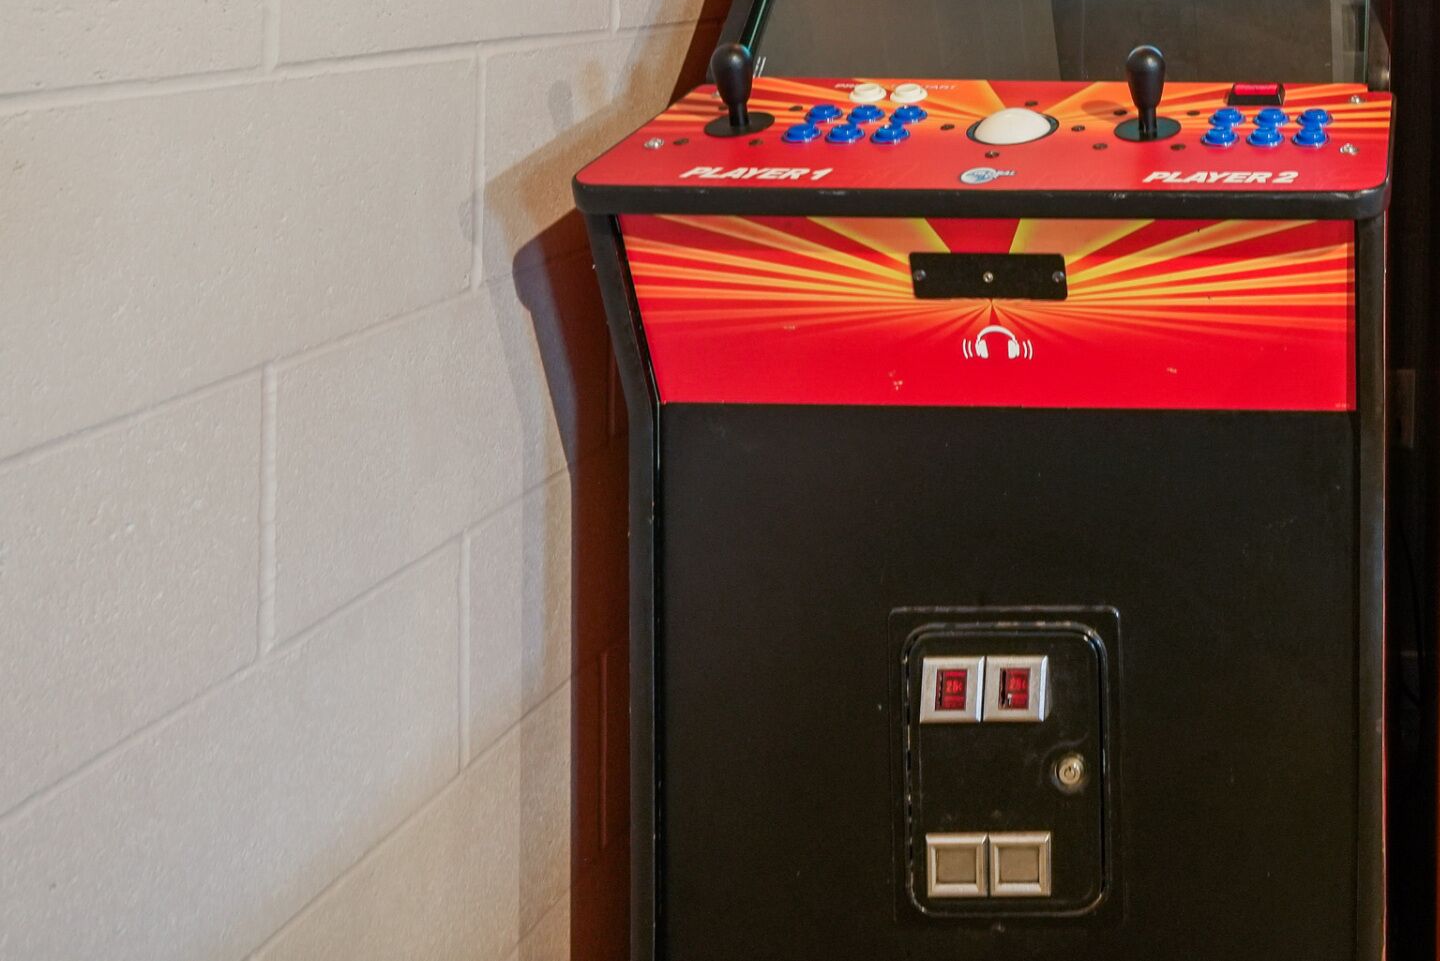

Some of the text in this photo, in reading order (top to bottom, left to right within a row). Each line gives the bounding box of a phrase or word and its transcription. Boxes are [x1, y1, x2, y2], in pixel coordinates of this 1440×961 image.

[678, 166, 833, 181] PLAYER 1
[1142, 170, 1299, 184] PLAYER 2
